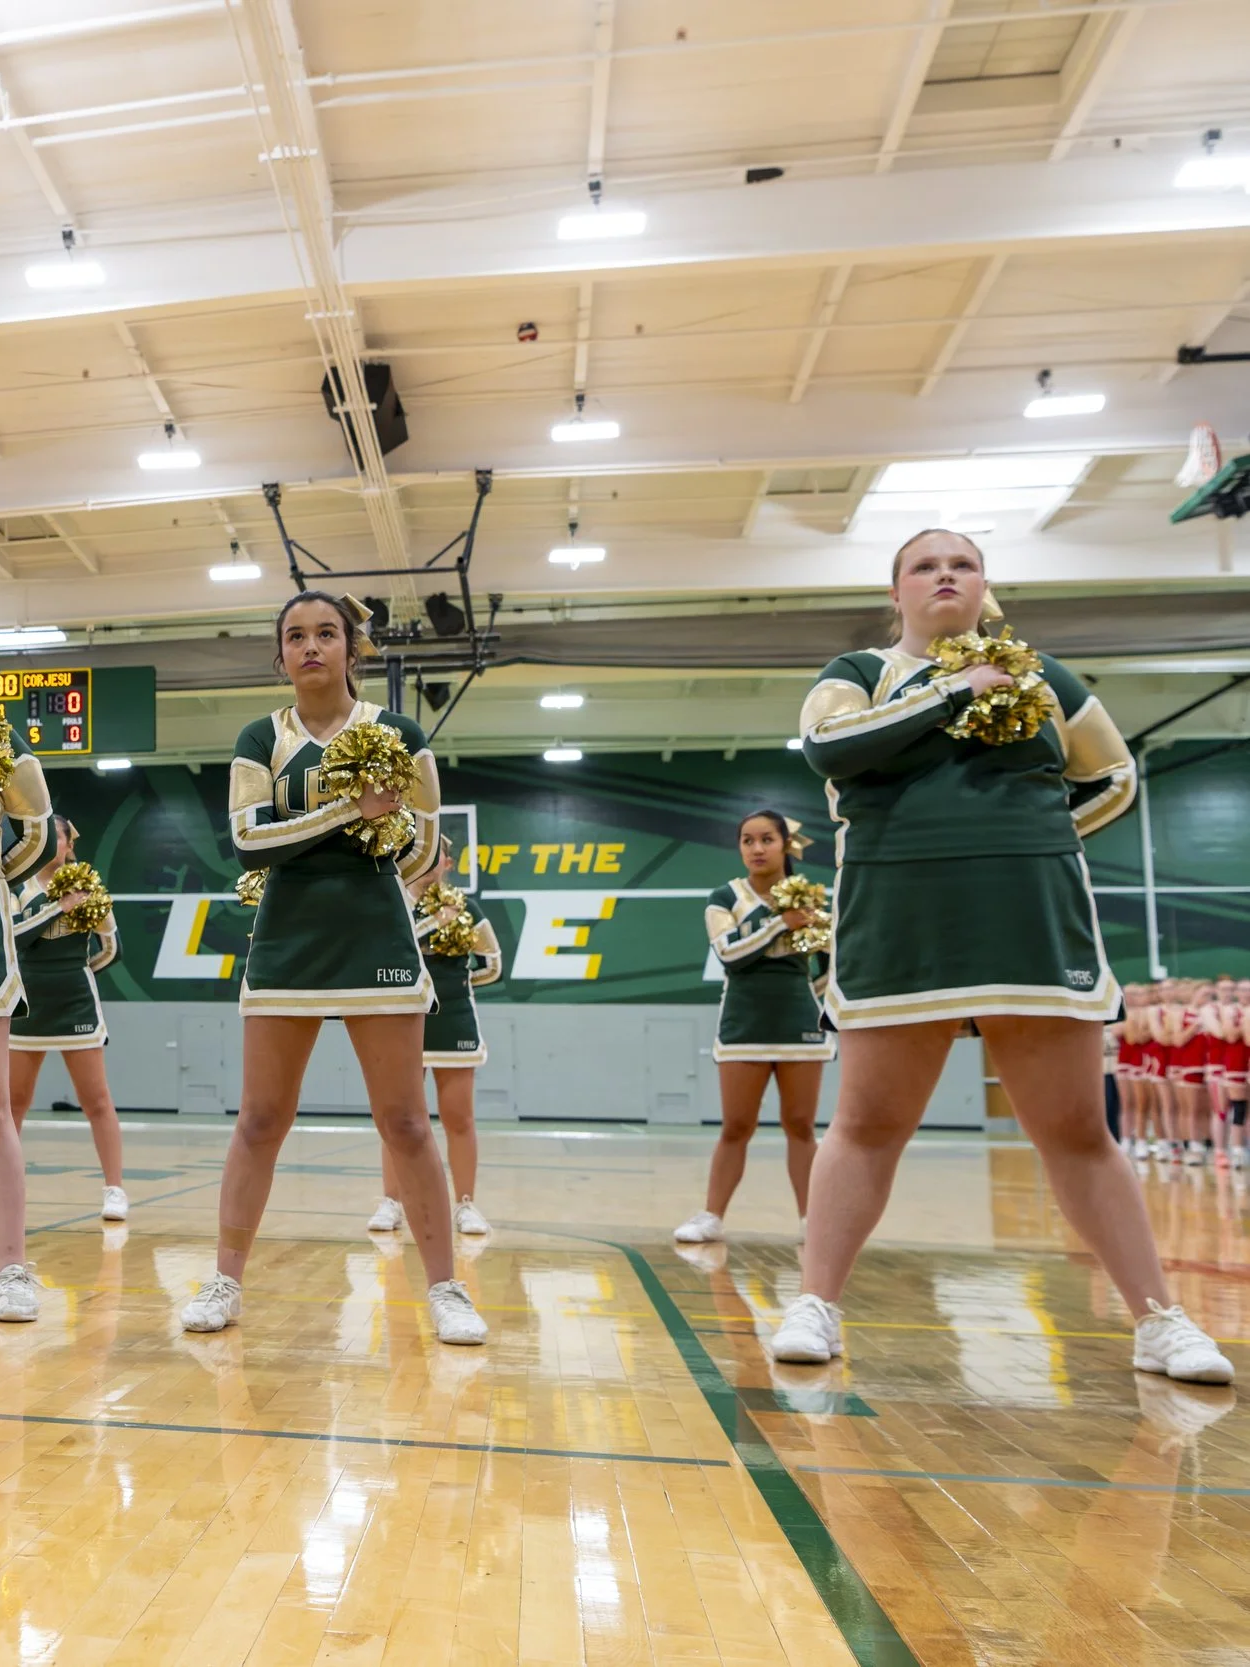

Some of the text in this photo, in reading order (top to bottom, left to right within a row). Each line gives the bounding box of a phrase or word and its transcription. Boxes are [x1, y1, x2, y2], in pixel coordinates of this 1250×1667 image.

[457, 843, 626, 875] OF THE
[377, 968, 413, 982] FLYERS
